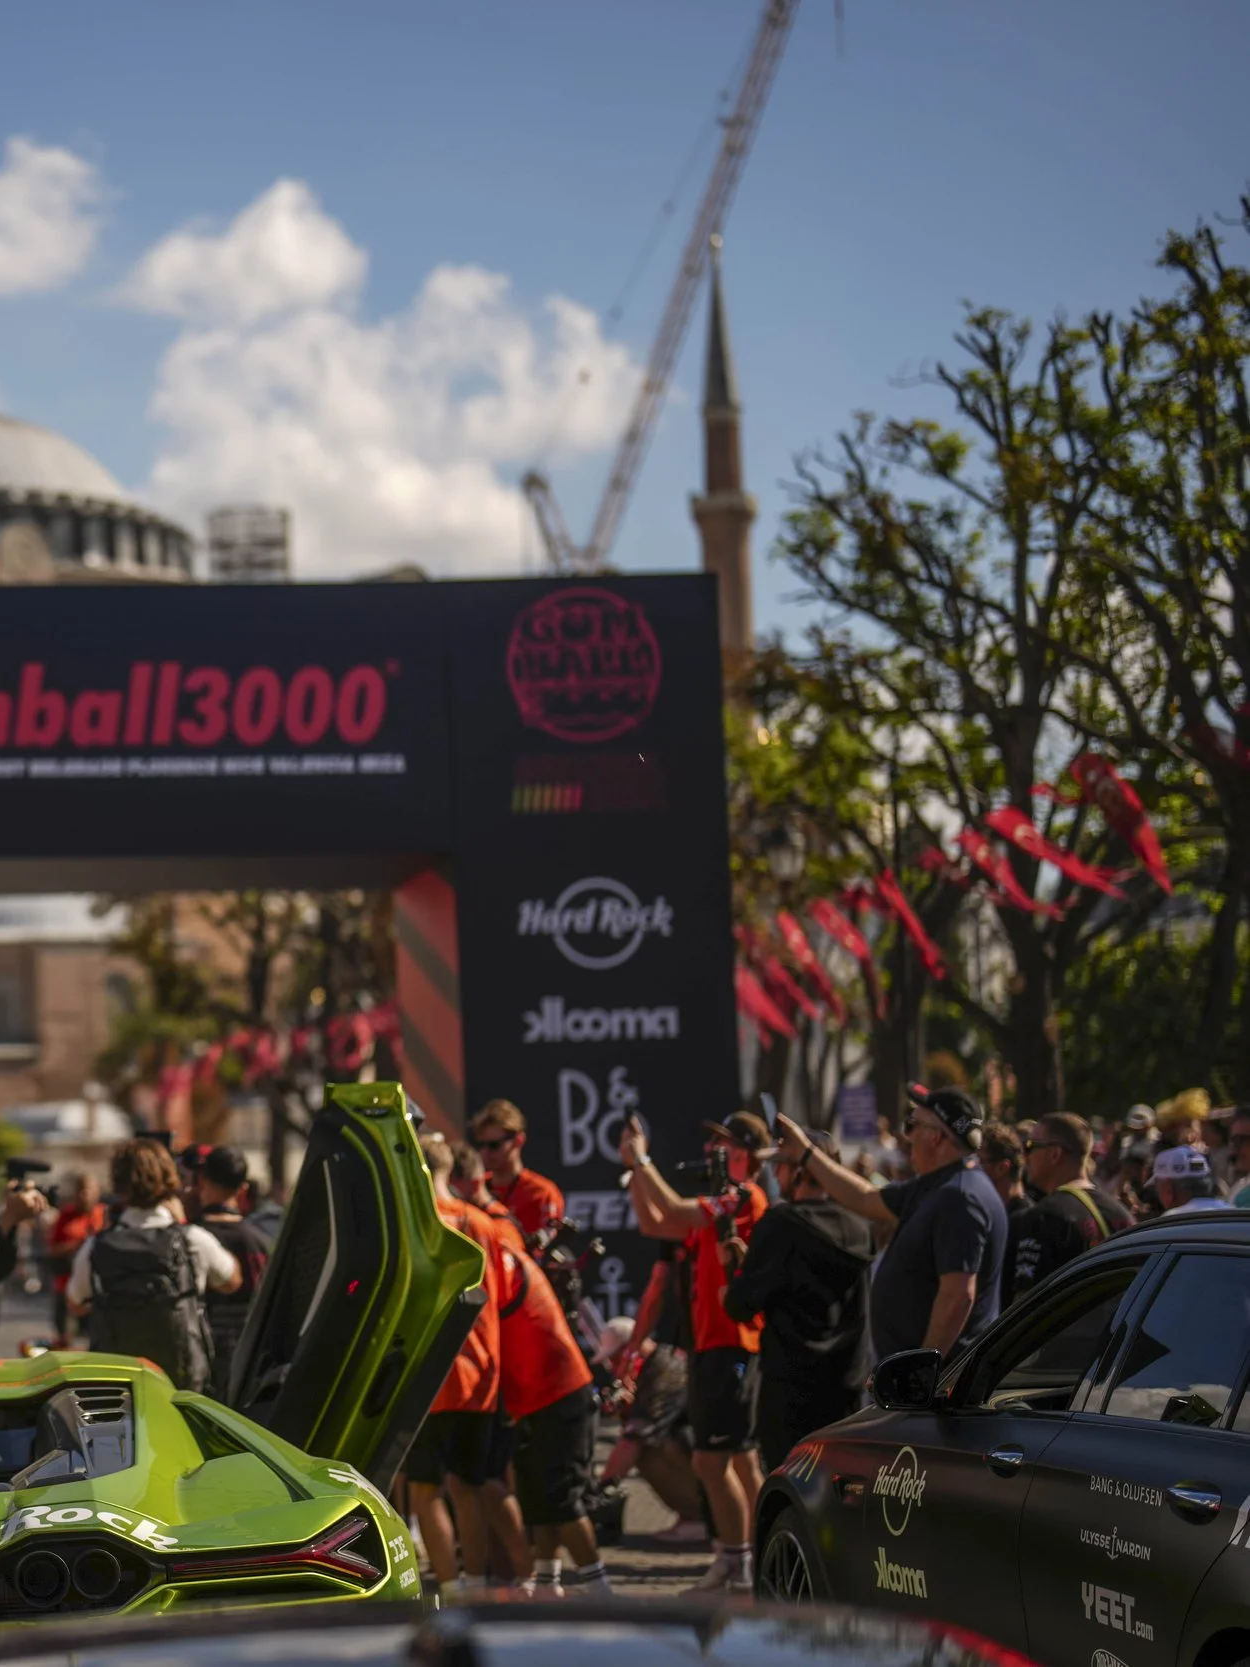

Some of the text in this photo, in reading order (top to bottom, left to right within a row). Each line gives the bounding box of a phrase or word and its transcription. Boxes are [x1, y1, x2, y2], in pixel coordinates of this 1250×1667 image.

[518, 896, 674, 940] Hard Rock
[873, 1465, 927, 1507] Hard Rock
[1090, 1475, 1163, 1507] BANG & OLUFSEN
[1080, 1529, 1151, 1561] ULYSSE NARDIN
[1081, 1581, 1154, 1641] YEET.com
